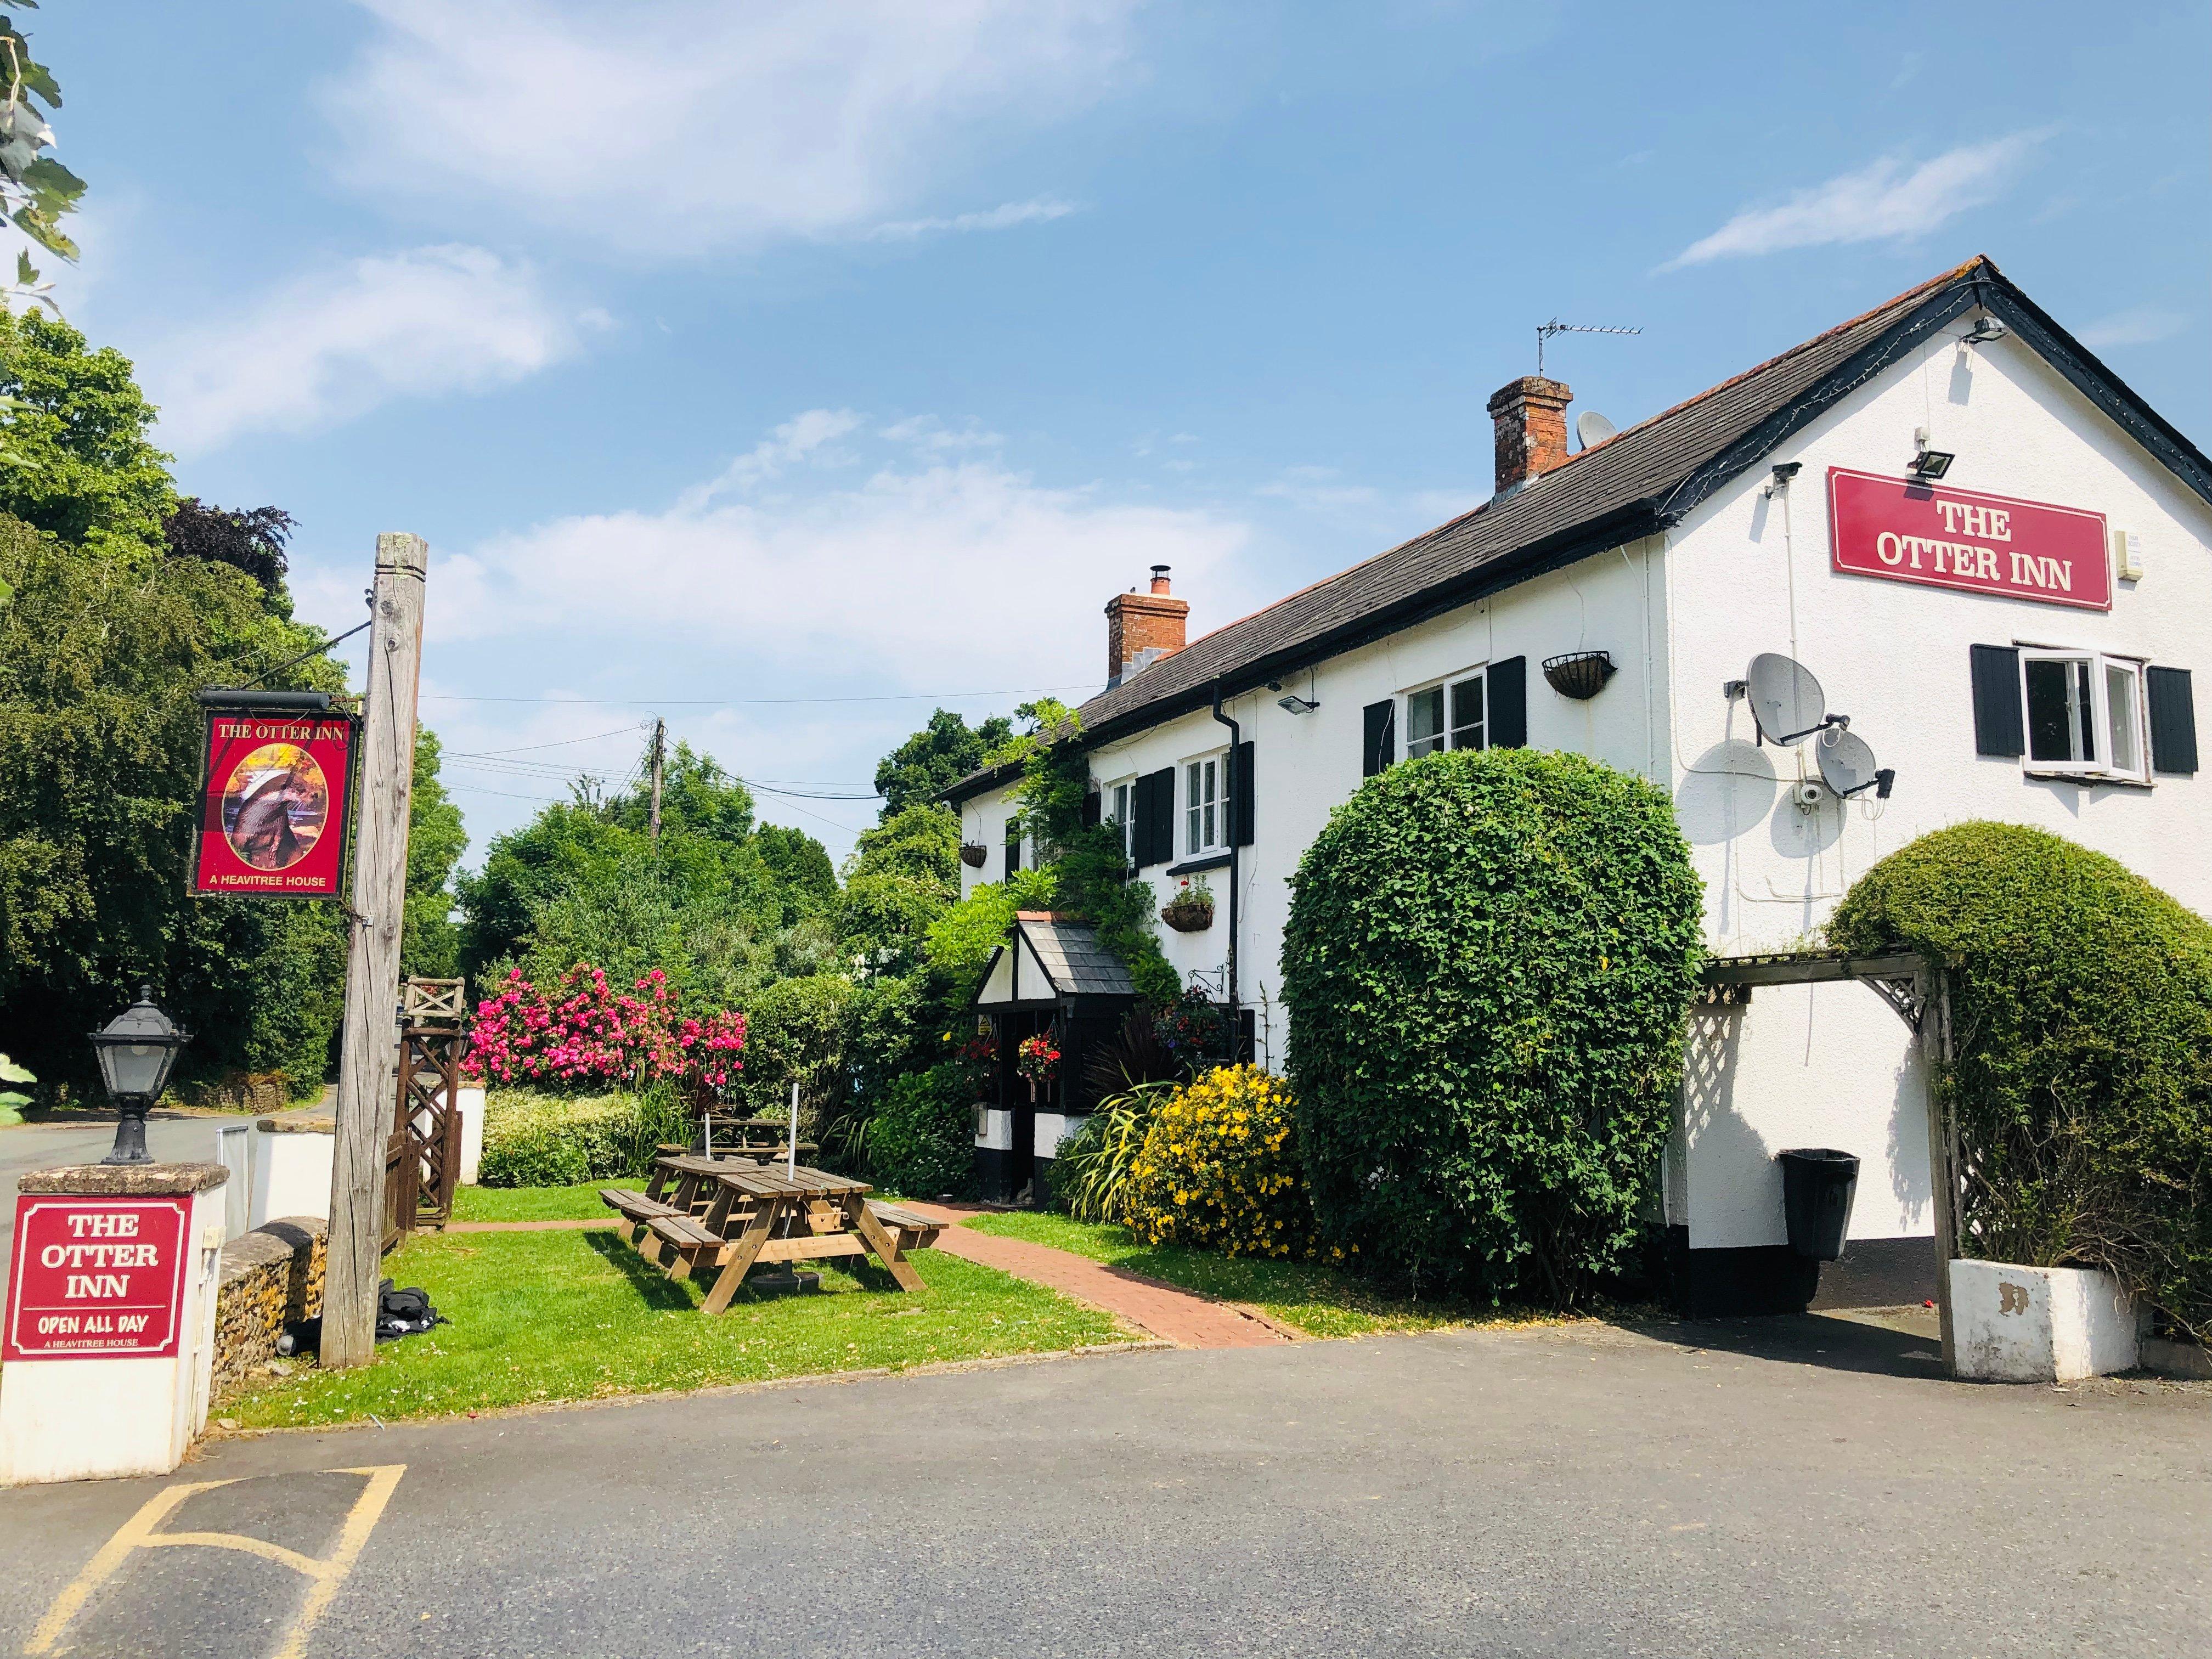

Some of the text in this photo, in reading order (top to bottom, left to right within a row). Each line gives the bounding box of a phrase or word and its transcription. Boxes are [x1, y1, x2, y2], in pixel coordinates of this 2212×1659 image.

[1937, 499, 2012, 542] THE
[1876, 531, 2072, 592] OTTER INN
[218, 724, 344, 740] THE OTTER INN
[209, 874, 326, 887] A HEAVITREE HOUSE
[67, 1214, 139, 1238] THE
[41, 1244, 159, 1269] OTTER
[64, 1274, 131, 1299] INN
[37, 1314, 149, 1335] OPEN ALL DAY
[43, 1338, 138, 1348] A HEAVITREE HOUSE
